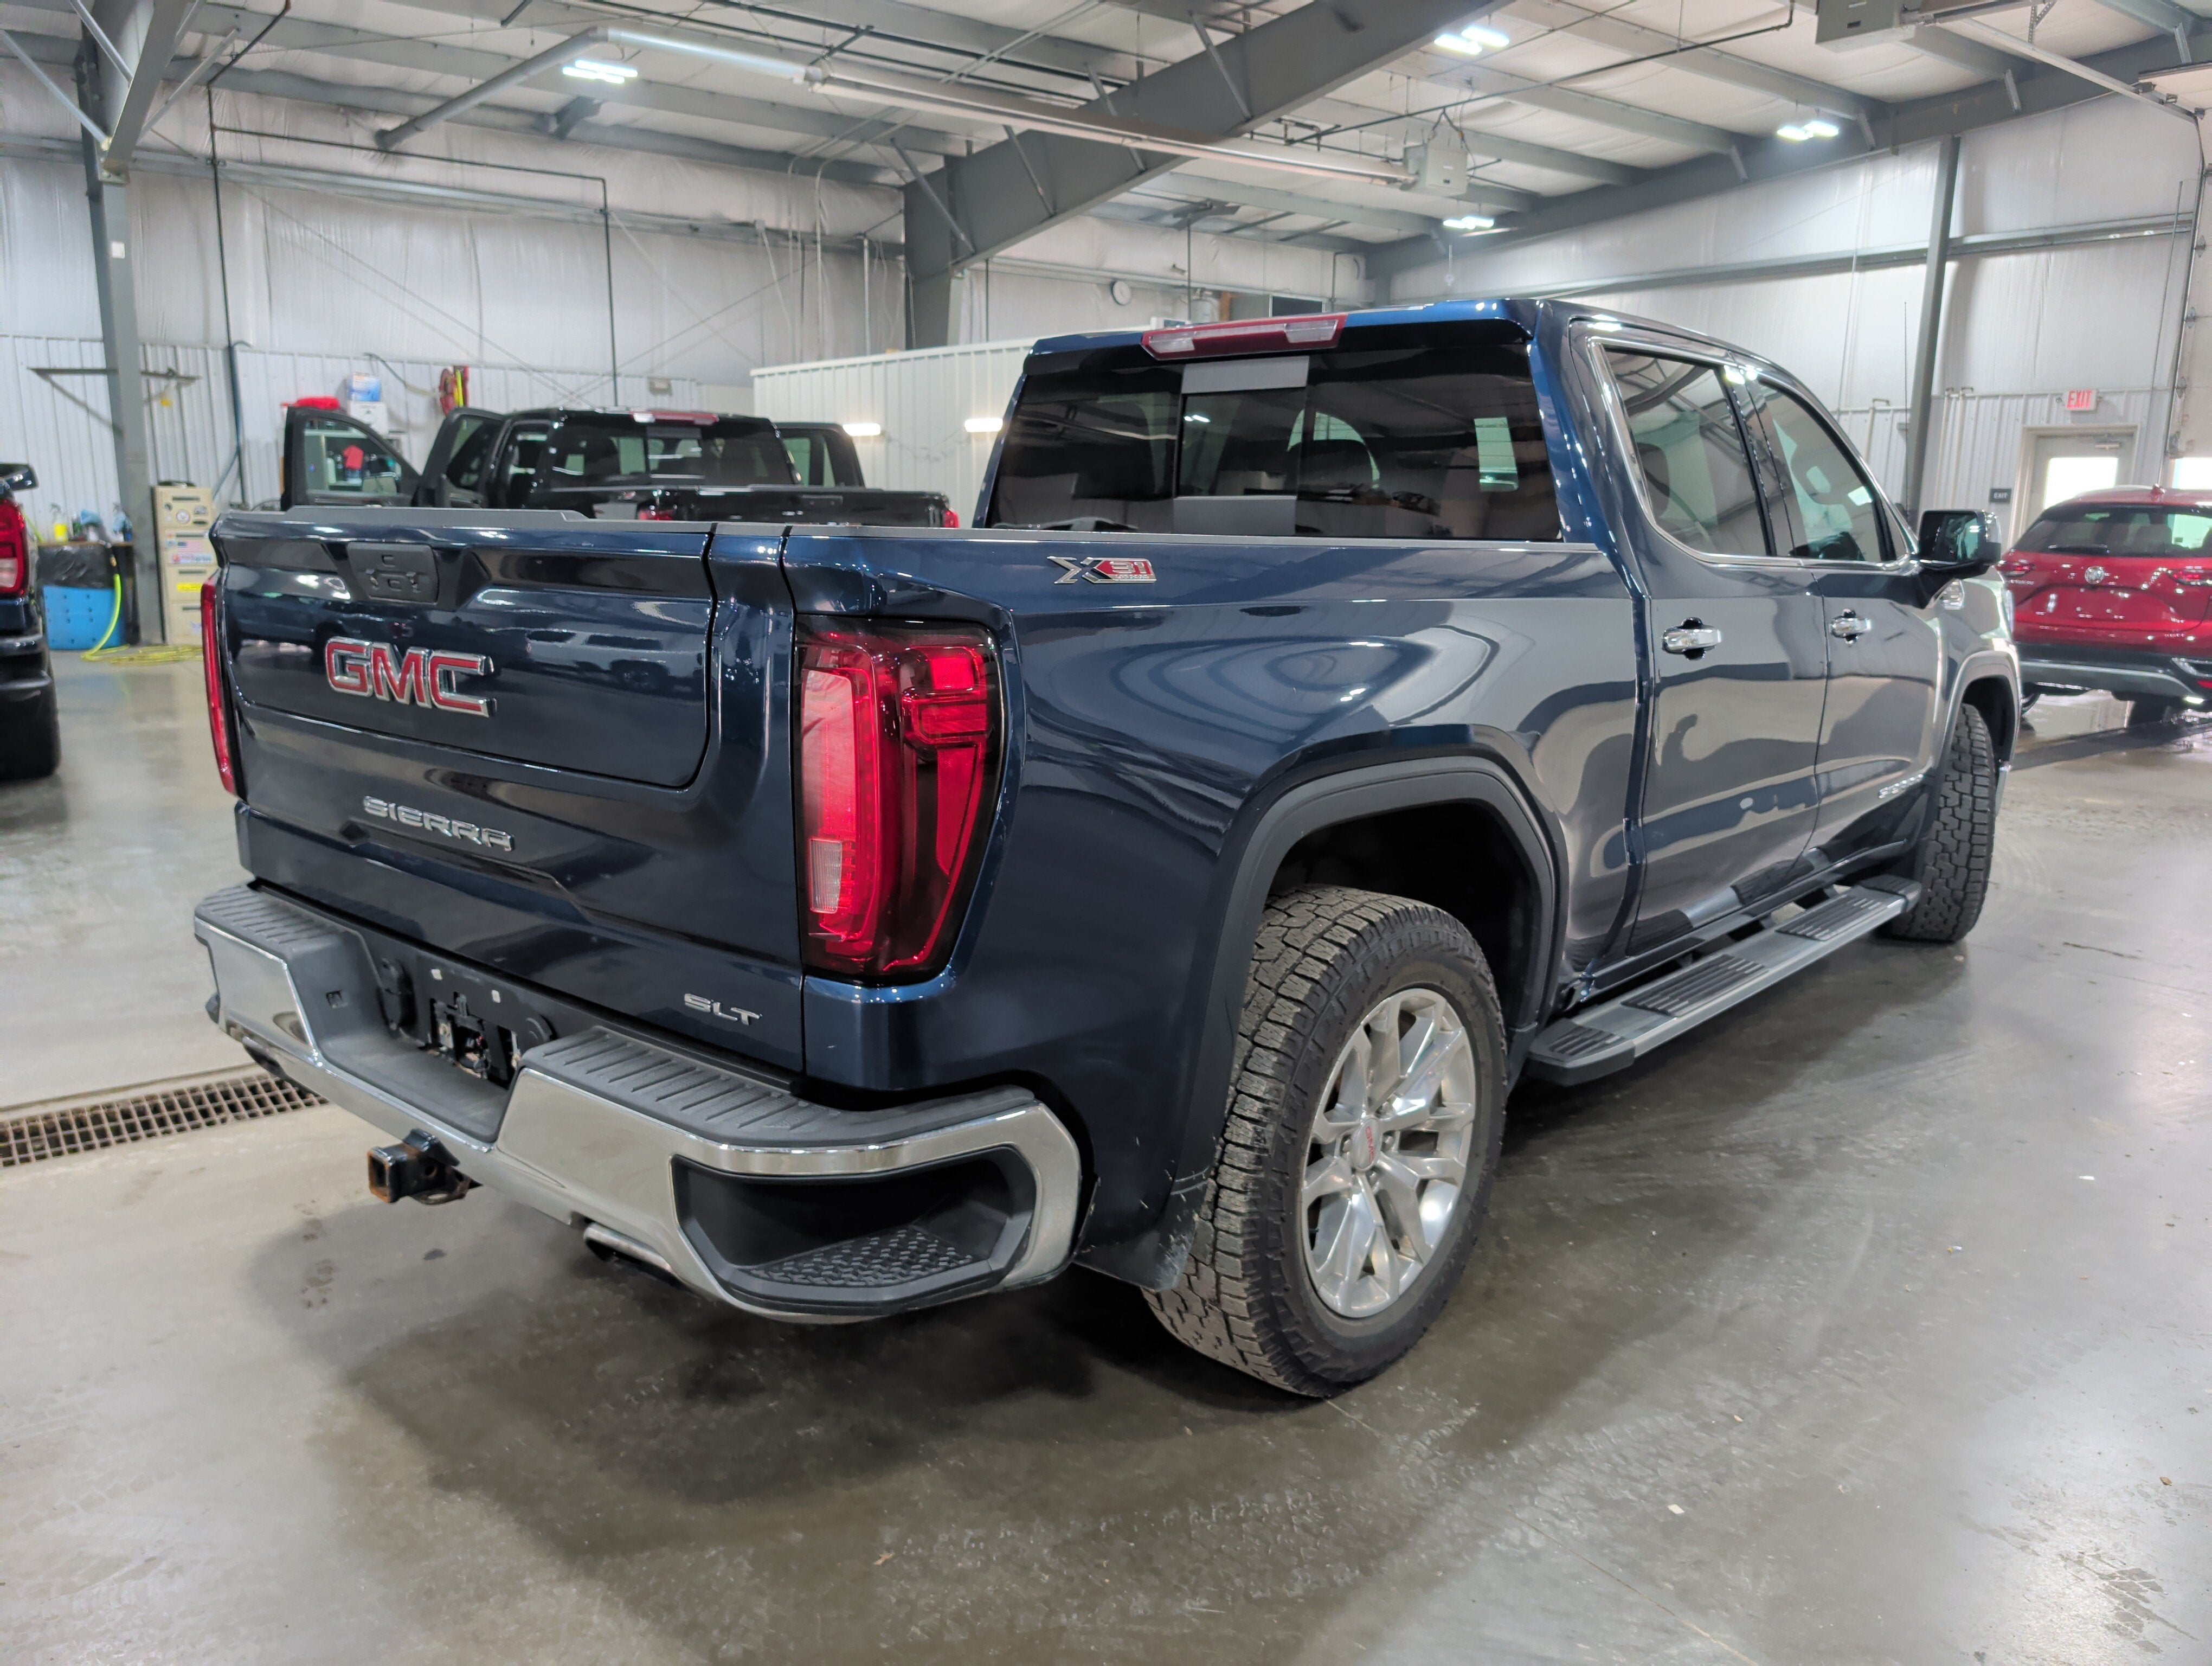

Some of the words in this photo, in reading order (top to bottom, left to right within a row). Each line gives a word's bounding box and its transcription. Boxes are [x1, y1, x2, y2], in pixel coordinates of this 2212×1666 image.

[2066, 390, 2093, 409] EXIT
[326, 636, 491, 717] GMC
[363, 796, 513, 851] SIERRA
[684, 993, 760, 1026] SLT
[1366, 1126, 1375, 1164] GMC
